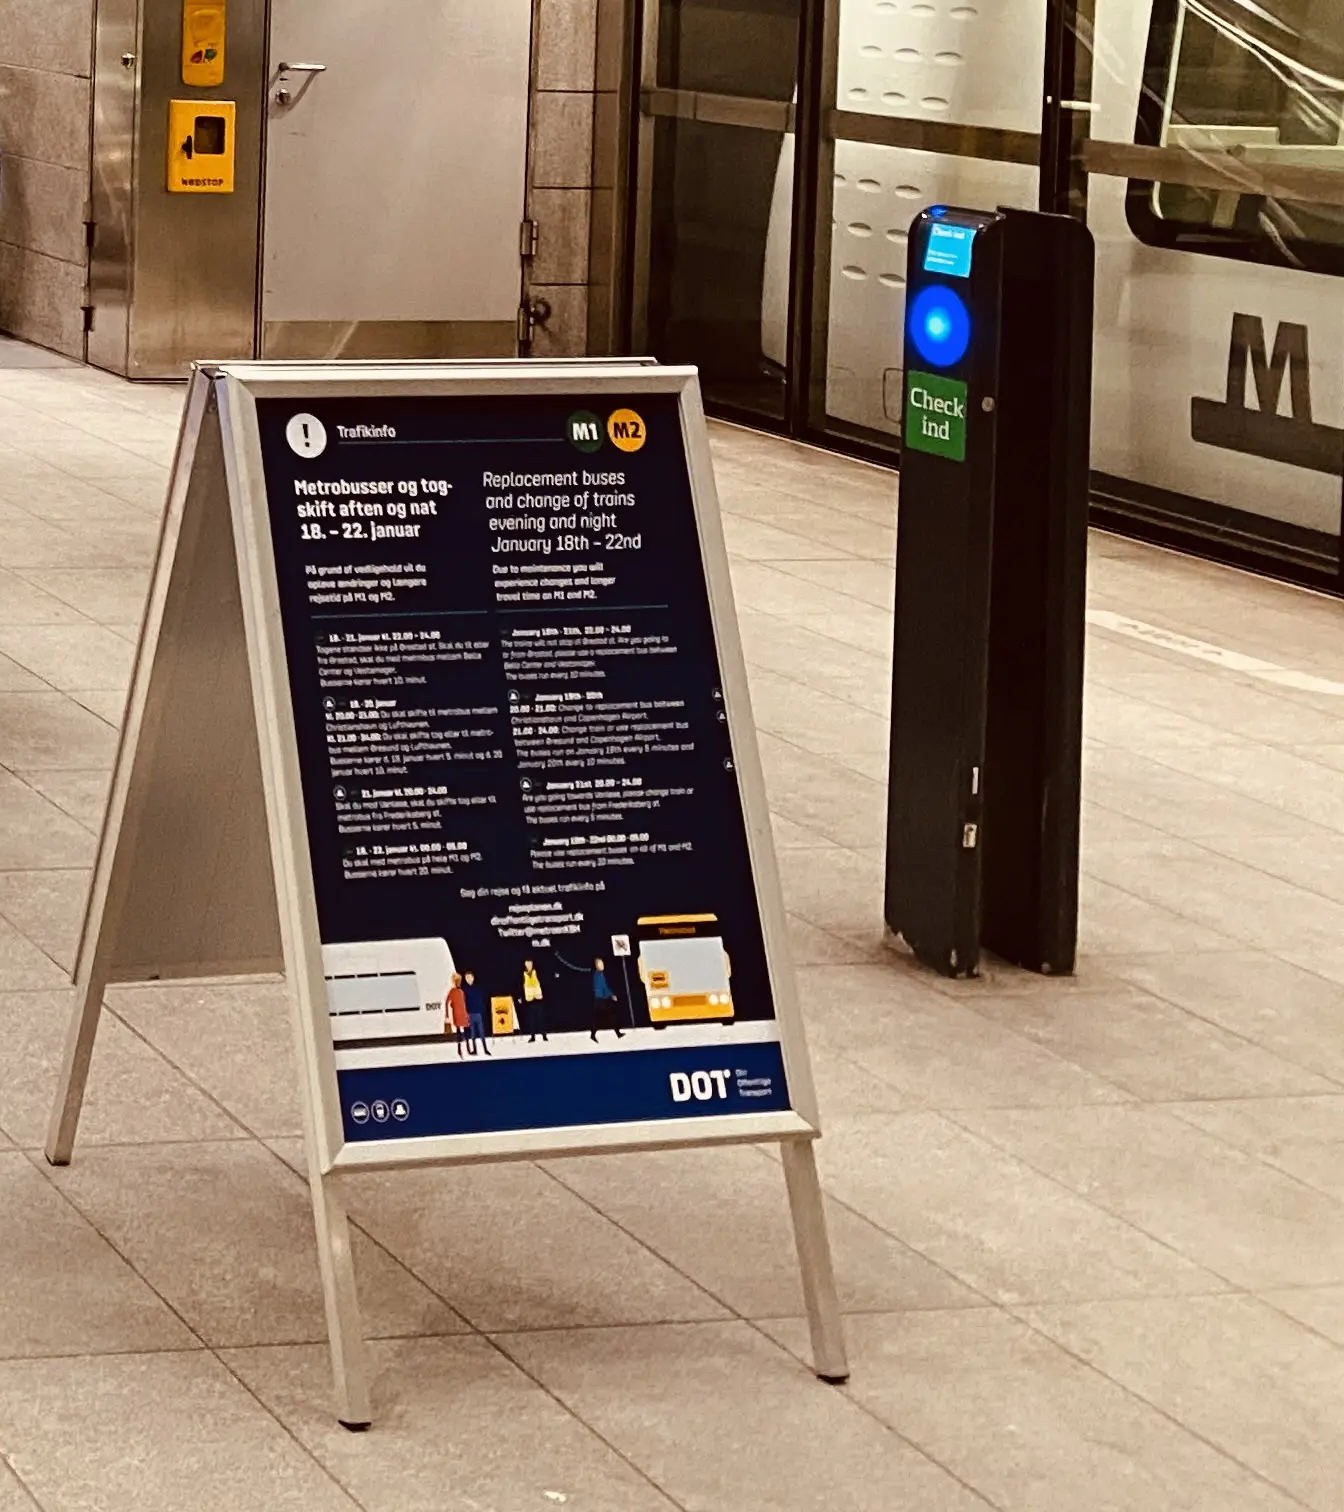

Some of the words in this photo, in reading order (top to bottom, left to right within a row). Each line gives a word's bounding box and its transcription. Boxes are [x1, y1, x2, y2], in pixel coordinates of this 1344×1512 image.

[910, 387, 964, 419] Check
[336, 424, 396, 438] Trafikinfo
[572, 422, 598, 440] M1
[613, 422, 642, 439] M2
[922, 416, 950, 441] ind
[294, 479, 393, 495] Metrobusser
[397, 480, 418, 497] og
[420, 478, 452, 496] tog-
[482, 471, 577, 489] Replacement
[582, 470, 625, 485] buses
[296, 499, 336, 517] skift
[339, 499, 383, 517] aften
[386, 502, 407, 519] og
[409, 499, 437, 515] nat
[485, 493, 513, 509] and
[516, 493, 570, 511] change
[573, 490, 589, 510] of
[592, 489, 635, 506] trains
[300, 522, 326, 540] 18.
[341, 522, 368, 539] 22.
[370, 520, 420, 541] januar
[488, 513, 545, 532] evening
[549, 513, 576, 529] and
[580, 512, 617, 531] night
[491, 536, 551, 554] January
[556, 534, 589, 551] 18th
[605, 533, 641, 550] 22nd
[668, 1069, 732, 1102] DOT
